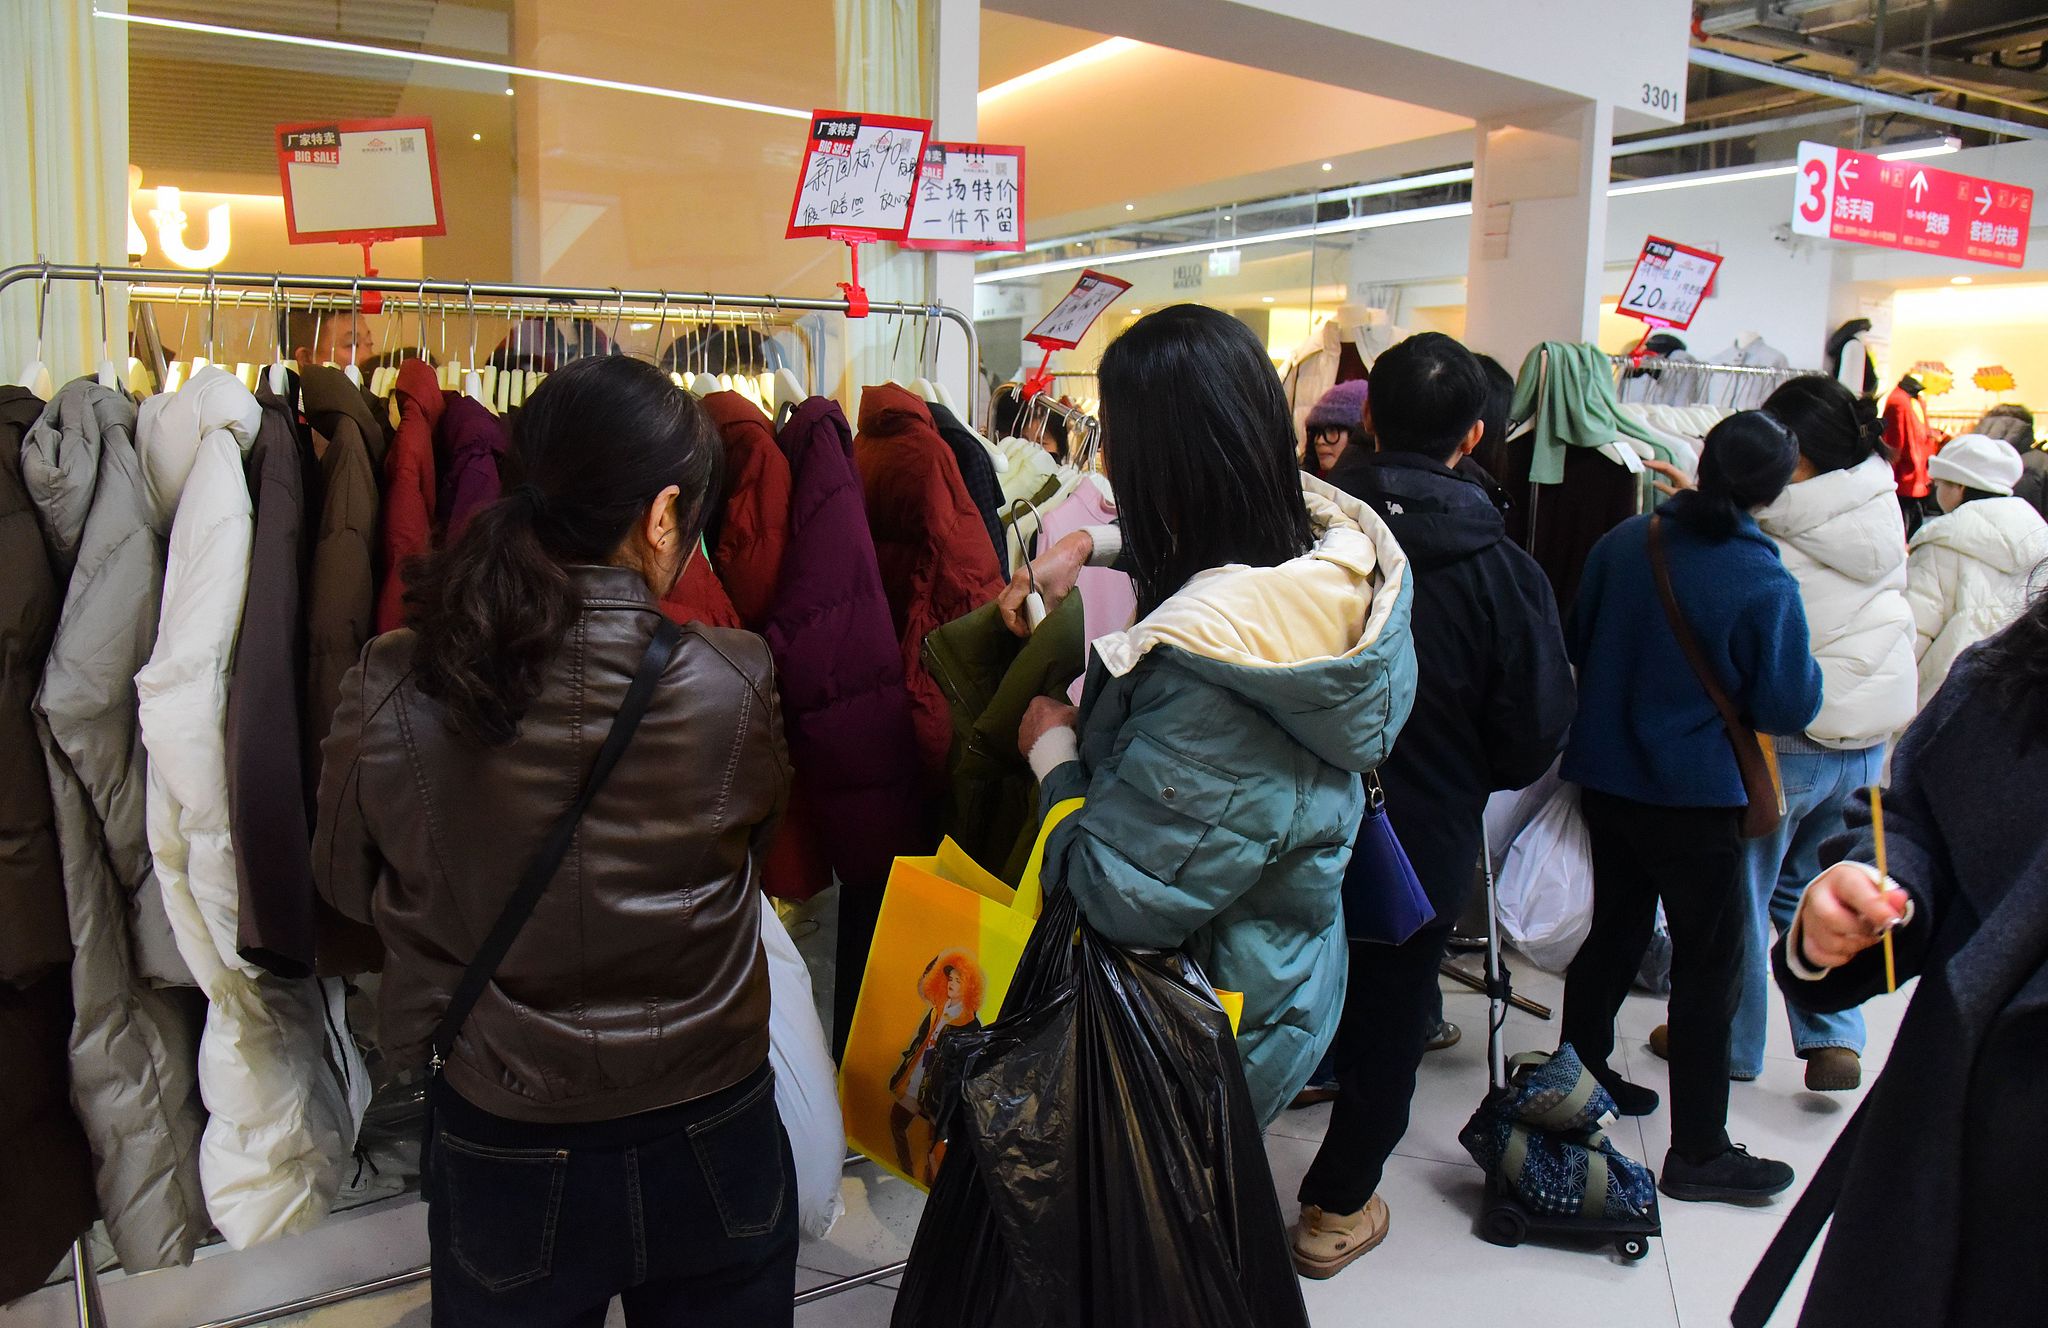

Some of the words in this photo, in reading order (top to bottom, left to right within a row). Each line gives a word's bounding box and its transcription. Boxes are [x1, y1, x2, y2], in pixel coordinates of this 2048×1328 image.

[1642, 83, 1678, 112] 3301
[287, 131, 336, 147] 厂家特卖
[818, 121, 857, 137] 厂家特卖
[295, 150, 312, 162] BIG
[313, 151, 337, 163] SALE
[818, 140, 831, 153] BIG
[832, 142, 851, 157] SALE
[921, 166, 943, 179] SALE
[920, 178, 1018, 203] 全场特价
[1800, 158, 1828, 223] 3
[923, 207, 1013, 234] 一件不留
[1834, 195, 1874, 223] 洗手间
[1970, 220, 2020, 248] 客梯/扶梯
[1629, 284, 1663, 308] 20
